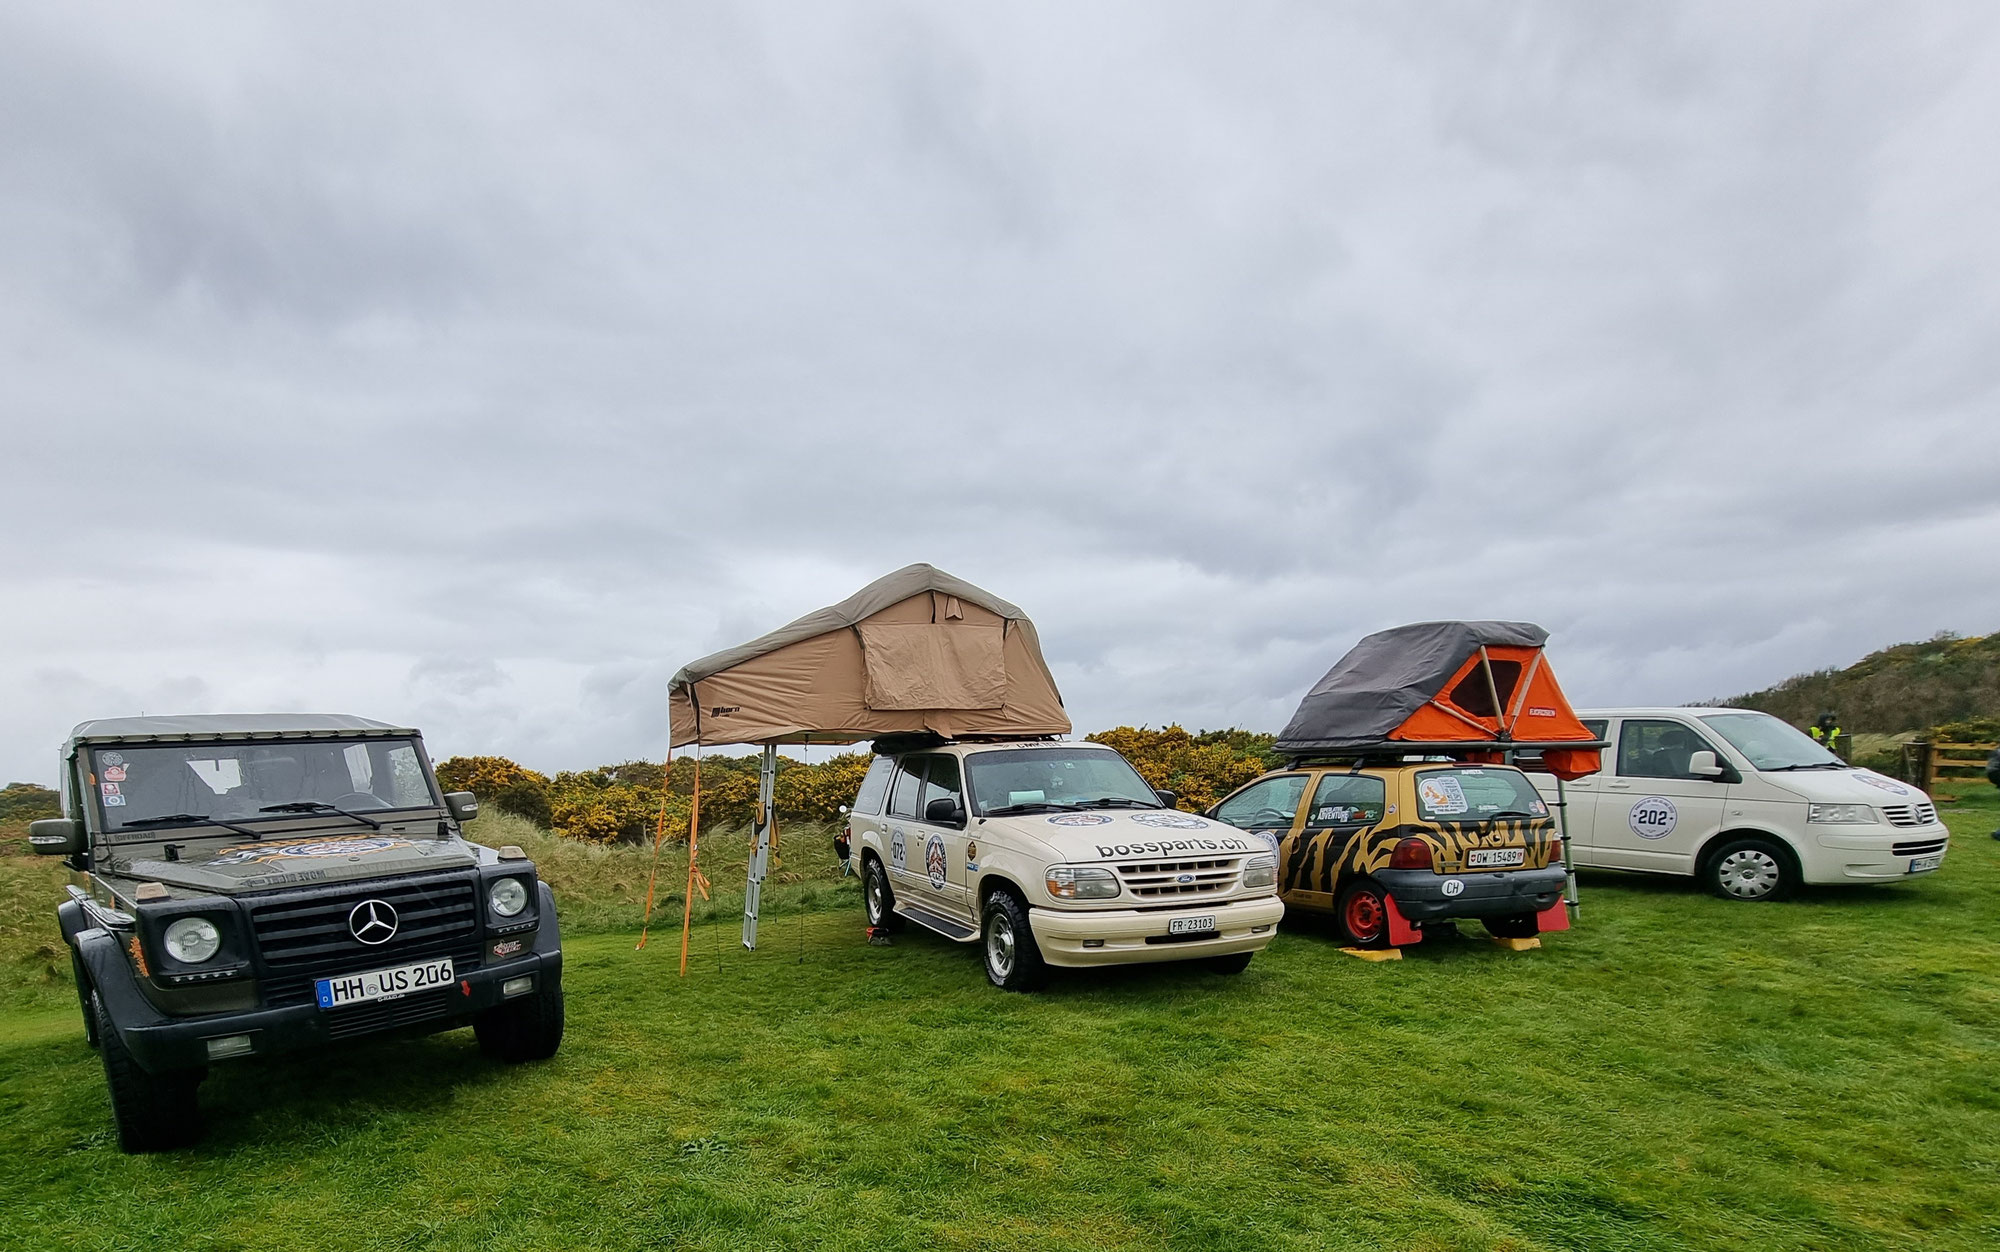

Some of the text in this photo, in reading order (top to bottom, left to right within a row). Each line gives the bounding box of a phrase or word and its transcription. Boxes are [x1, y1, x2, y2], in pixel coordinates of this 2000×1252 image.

[1638, 809, 1667, 826] 202
[892, 842, 904, 861] 072
[1095, 837, 1249, 858] bossparts.ch
[1446, 882, 1459, 894] CH
[332, 977, 365, 1002] HH
[379, 970, 409, 993] US
[413, 962, 452, 988] 206
